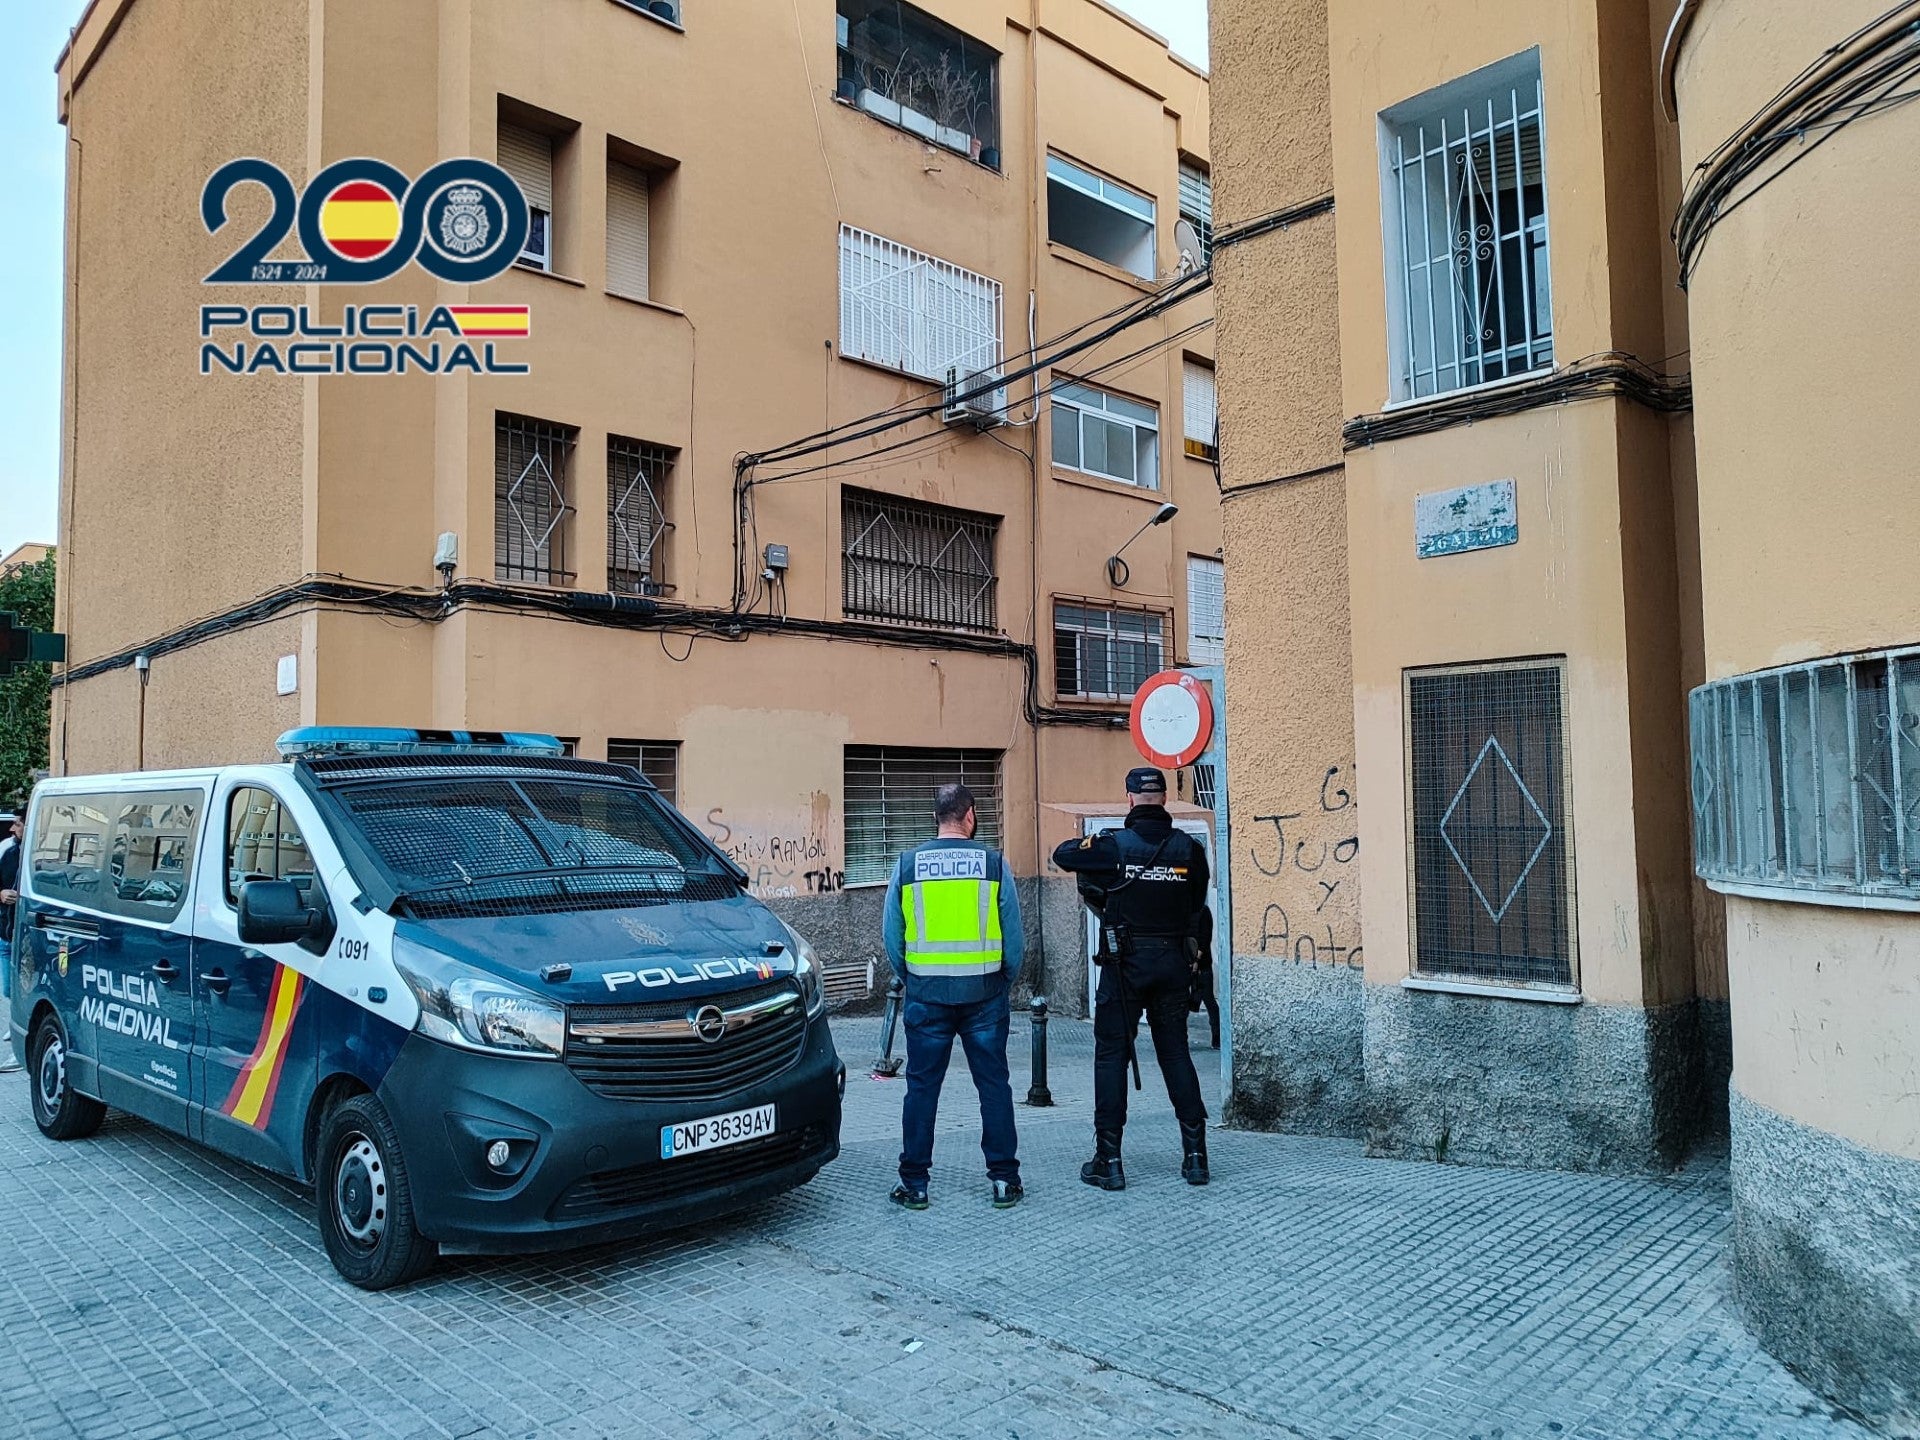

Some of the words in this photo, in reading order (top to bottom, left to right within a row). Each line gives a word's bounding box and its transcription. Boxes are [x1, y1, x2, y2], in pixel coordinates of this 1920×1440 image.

[944, 851, 973, 860] NACIONAL
[975, 851, 984, 859] DE
[917, 861, 983, 877] POLICIA
[1125, 872, 1187, 882] NCIONAL
[345, 939, 369, 961] 091
[602, 956, 758, 992] POLICÍA
[82, 964, 160, 1009] POLICÍA
[80, 995, 178, 1049] NACIONAL
